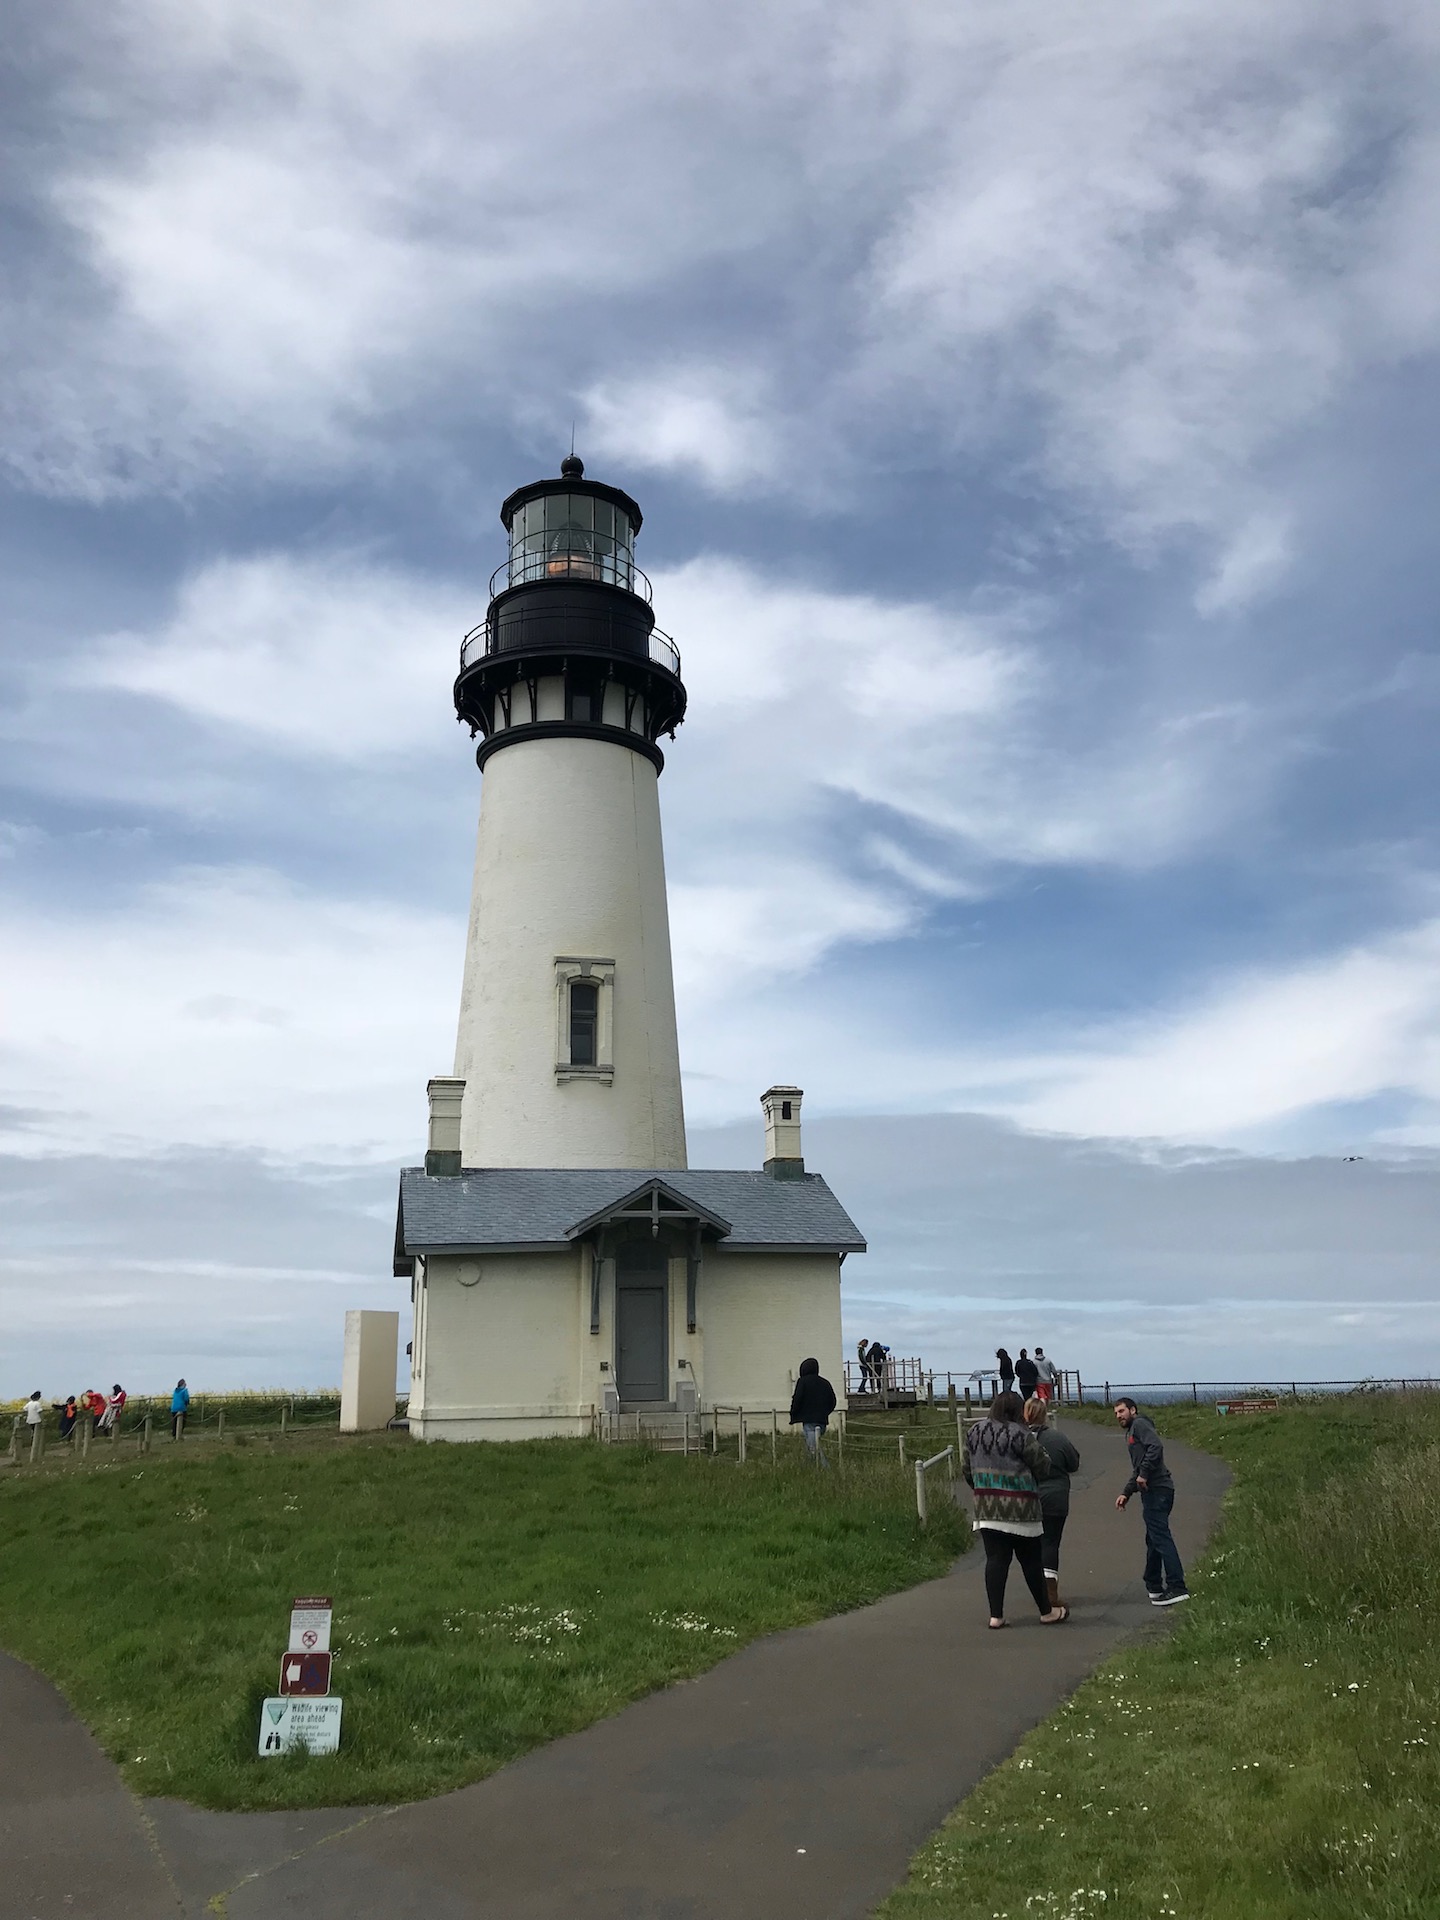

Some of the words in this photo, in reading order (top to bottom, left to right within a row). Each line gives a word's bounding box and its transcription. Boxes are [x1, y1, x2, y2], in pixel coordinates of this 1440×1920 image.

[291, 1703, 313, 1713] Wildlife
[315, 1703, 339, 1716] viewing
[290, 1715, 305, 1723] area
[307, 1714, 326, 1723] ahead
